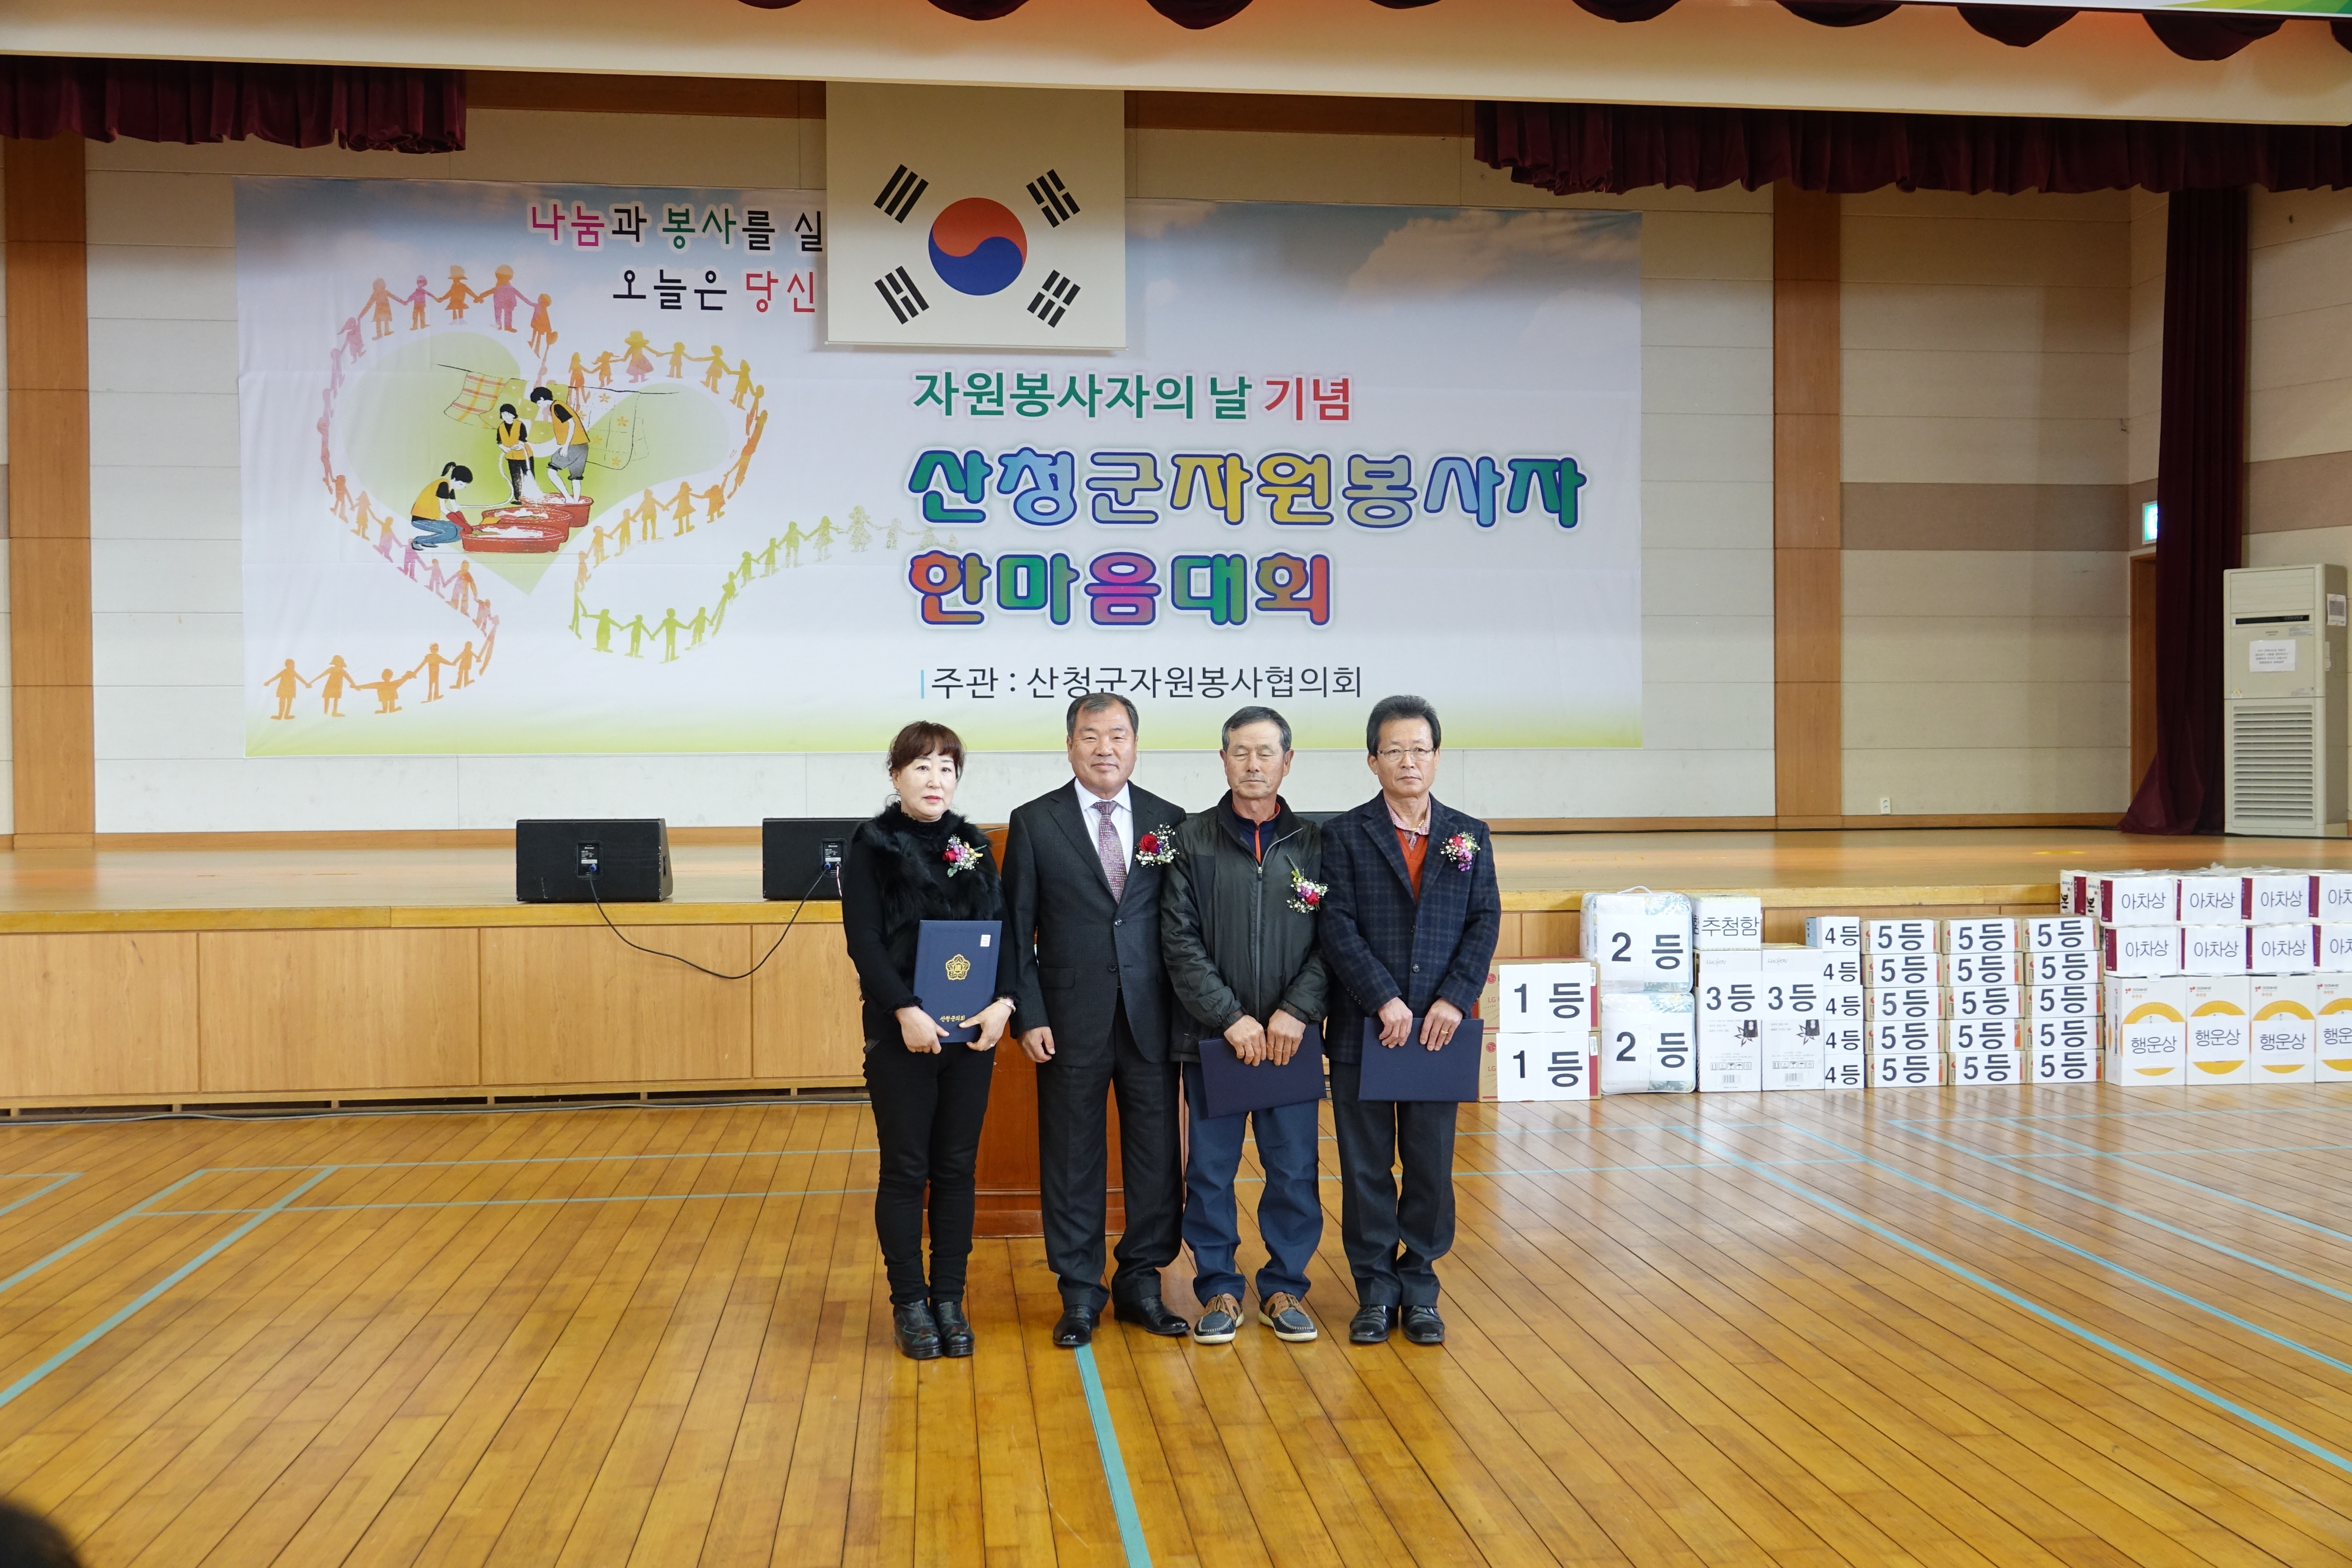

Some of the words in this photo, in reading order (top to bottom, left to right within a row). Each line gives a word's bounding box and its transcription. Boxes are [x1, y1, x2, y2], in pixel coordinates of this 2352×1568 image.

[532, 204, 647, 246] 나눔과
[662, 208, 775, 251] 봉사를
[794, 211, 823, 252] 실
[613, 270, 727, 311] 오늘은
[746, 271, 815, 313] 당신
[913, 372, 1194, 420] 자원봉사자의
[1210, 375, 1252, 420] 날
[1265, 377, 1351, 422] 기념
[908, 446, 1588, 530] 산청군자원봉사자
[908, 550, 1331, 627] 한마음대회
[932, 667, 998, 699] 주관
[1027, 667, 1360, 699] 산청군자원봉사협의회
[2122, 892, 2166, 910] 아차상
[2190, 892, 2235, 909] 아차상
[2261, 891, 2303, 907] 아차상
[1702, 917, 1760, 937] 추첨함
[1825, 926, 1859, 946] 4등
[1878, 923, 1924, 950] 5등
[1959, 924, 2006, 950] 5등
[2038, 920, 2084, 947] 5등
[2125, 940, 2169, 957] 아차상
[2194, 941, 2239, 958] 아차상
[2262, 940, 2306, 957] 아차상
[1824, 962, 1857, 982] 4등
[1881, 956, 1927, 983] 5등
[1958, 956, 2005, 983] 5등
[2042, 953, 2088, 980] 5등
[1706, 984, 1755, 1012] 3등
[1768, 984, 1816, 1011] 3등
[1826, 996, 1860, 1016] 4등
[1882, 990, 1929, 1017] 5등
[1962, 988, 2009, 1015] 5등
[2040, 986, 2087, 1013] 5등
[1826, 1030, 1860, 1050] 4등
[1881, 1023, 1929, 1050] 5등
[1959, 1022, 2006, 1049] 5등
[2040, 1020, 2087, 1047] 5등
[2131, 1036, 2177, 1054] 행운상
[2195, 1029, 2241, 1046] 행운상
[2260, 1033, 2306, 1050] 행운상
[2324, 1028, 2352, 1044] 행운
[1825, 1065, 1860, 1084] 4등
[1882, 1056, 1929, 1083] 5등
[1964, 1054, 2011, 1081] 5등
[2041, 1052, 2087, 1079] 5등
